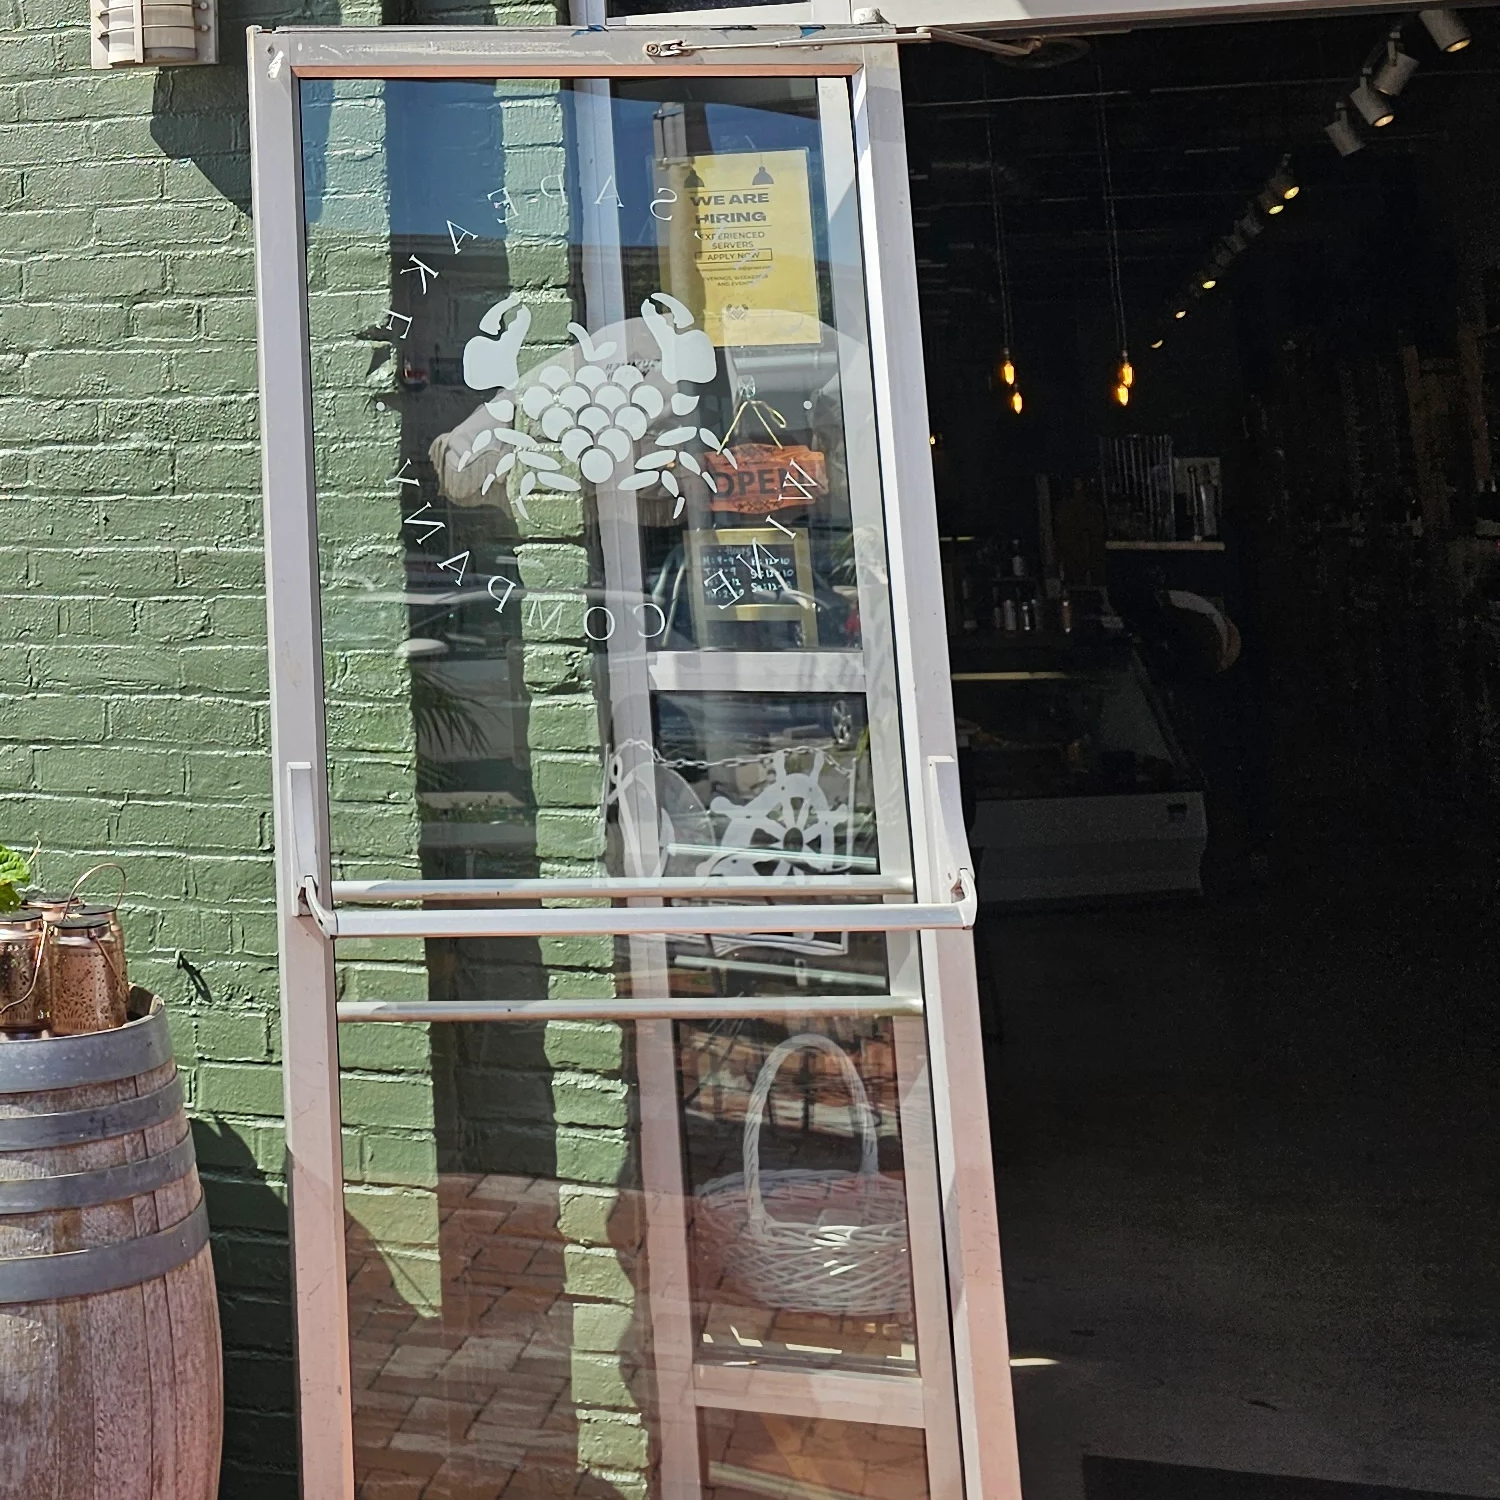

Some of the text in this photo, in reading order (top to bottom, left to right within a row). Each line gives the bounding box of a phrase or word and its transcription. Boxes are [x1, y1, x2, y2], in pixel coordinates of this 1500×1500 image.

[690, 192, 770, 207] WE ARE
[695, 211, 767, 225] HIRING
[711, 240, 755, 250] SERVERS
[707, 252, 735, 261] APPLY
[710, 467, 806, 499] OPEN
